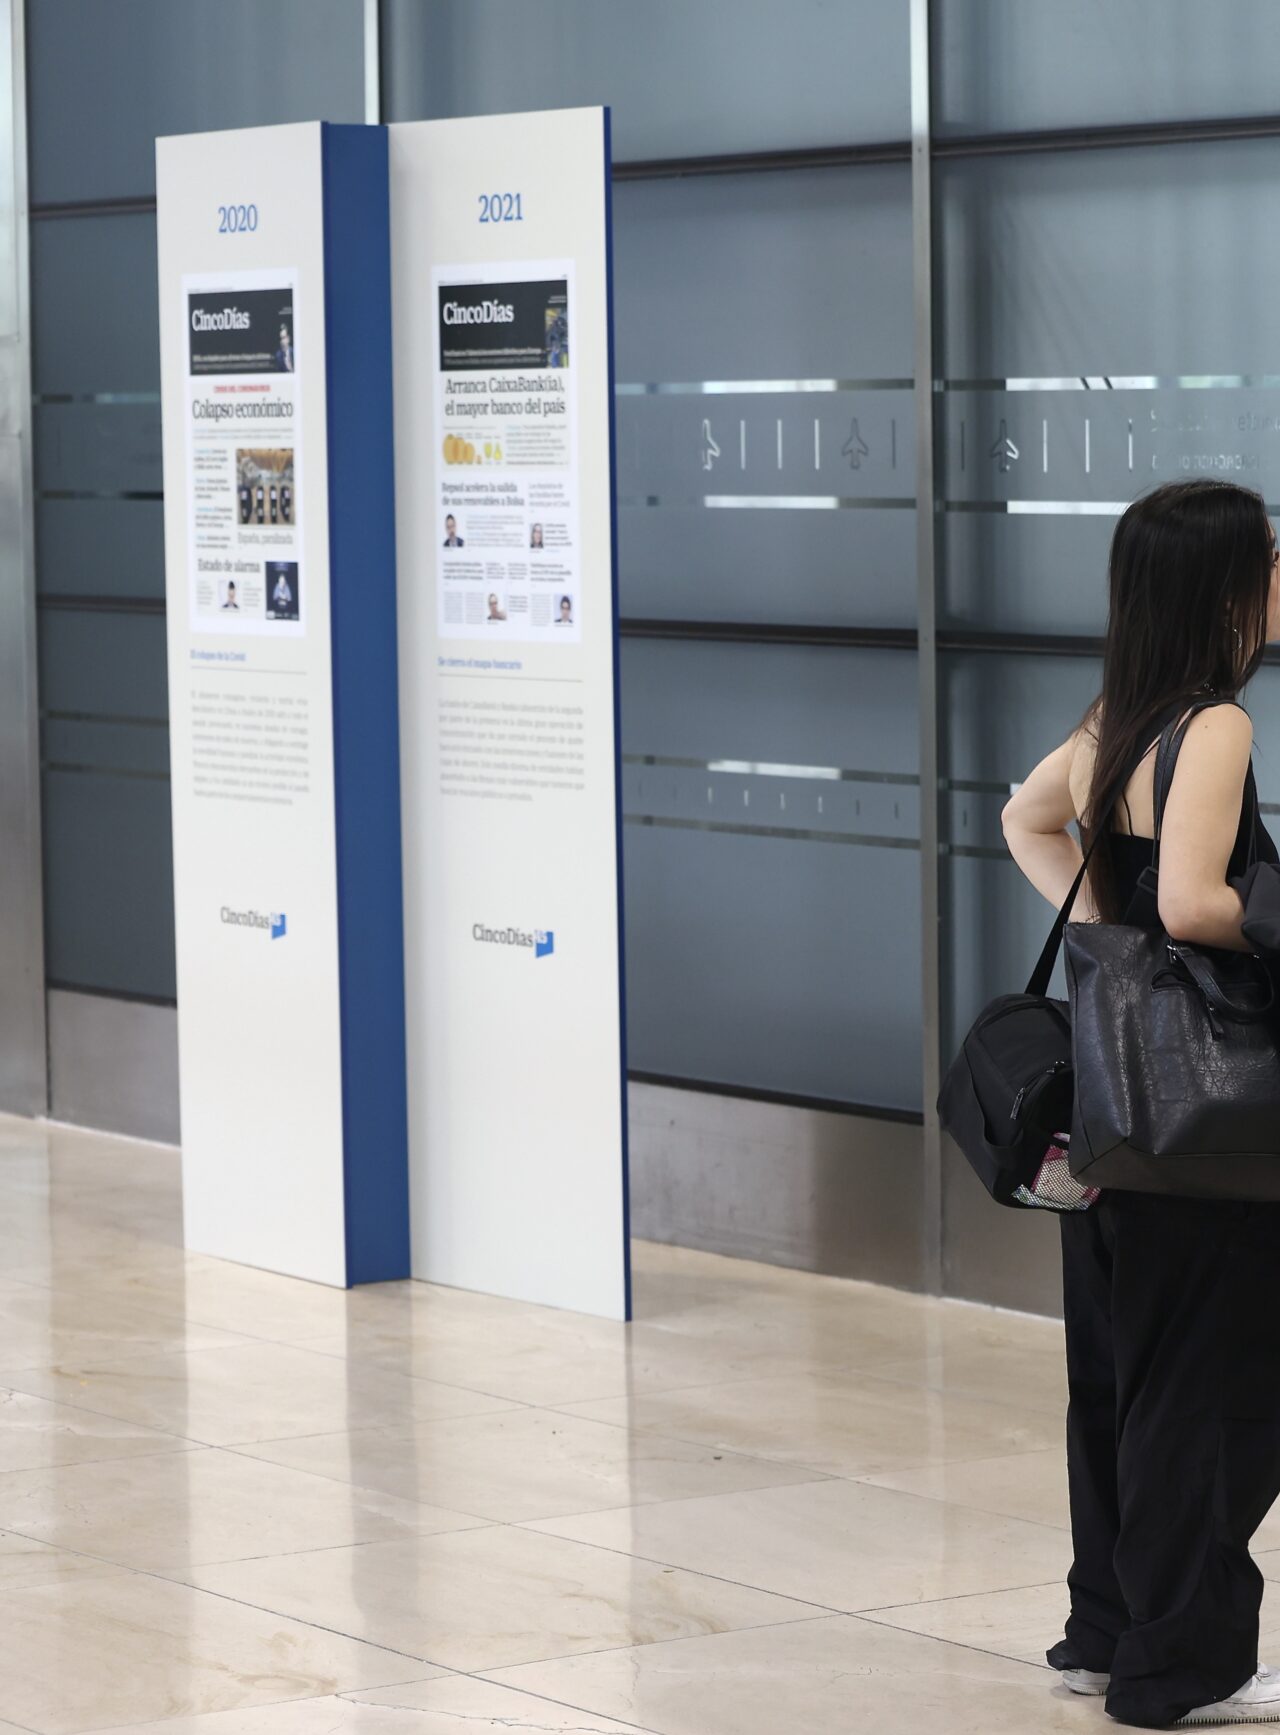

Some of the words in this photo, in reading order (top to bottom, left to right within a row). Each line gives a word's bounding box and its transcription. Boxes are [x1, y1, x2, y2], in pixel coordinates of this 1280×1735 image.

[218, 203, 258, 233] 2020
[478, 193, 523, 223] 2021
[191, 307, 250, 332] CincoDías
[443, 299, 514, 326] CincoDías
[445, 377, 486, 394] Arranca
[192, 398, 234, 422] Colapso
[234, 397, 293, 419] económico
[444, 399, 454, 416] el
[455, 402, 489, 417] mayor
[490, 398, 523, 415] banco
[524, 397, 541, 414] del
[543, 398, 565, 416] país
